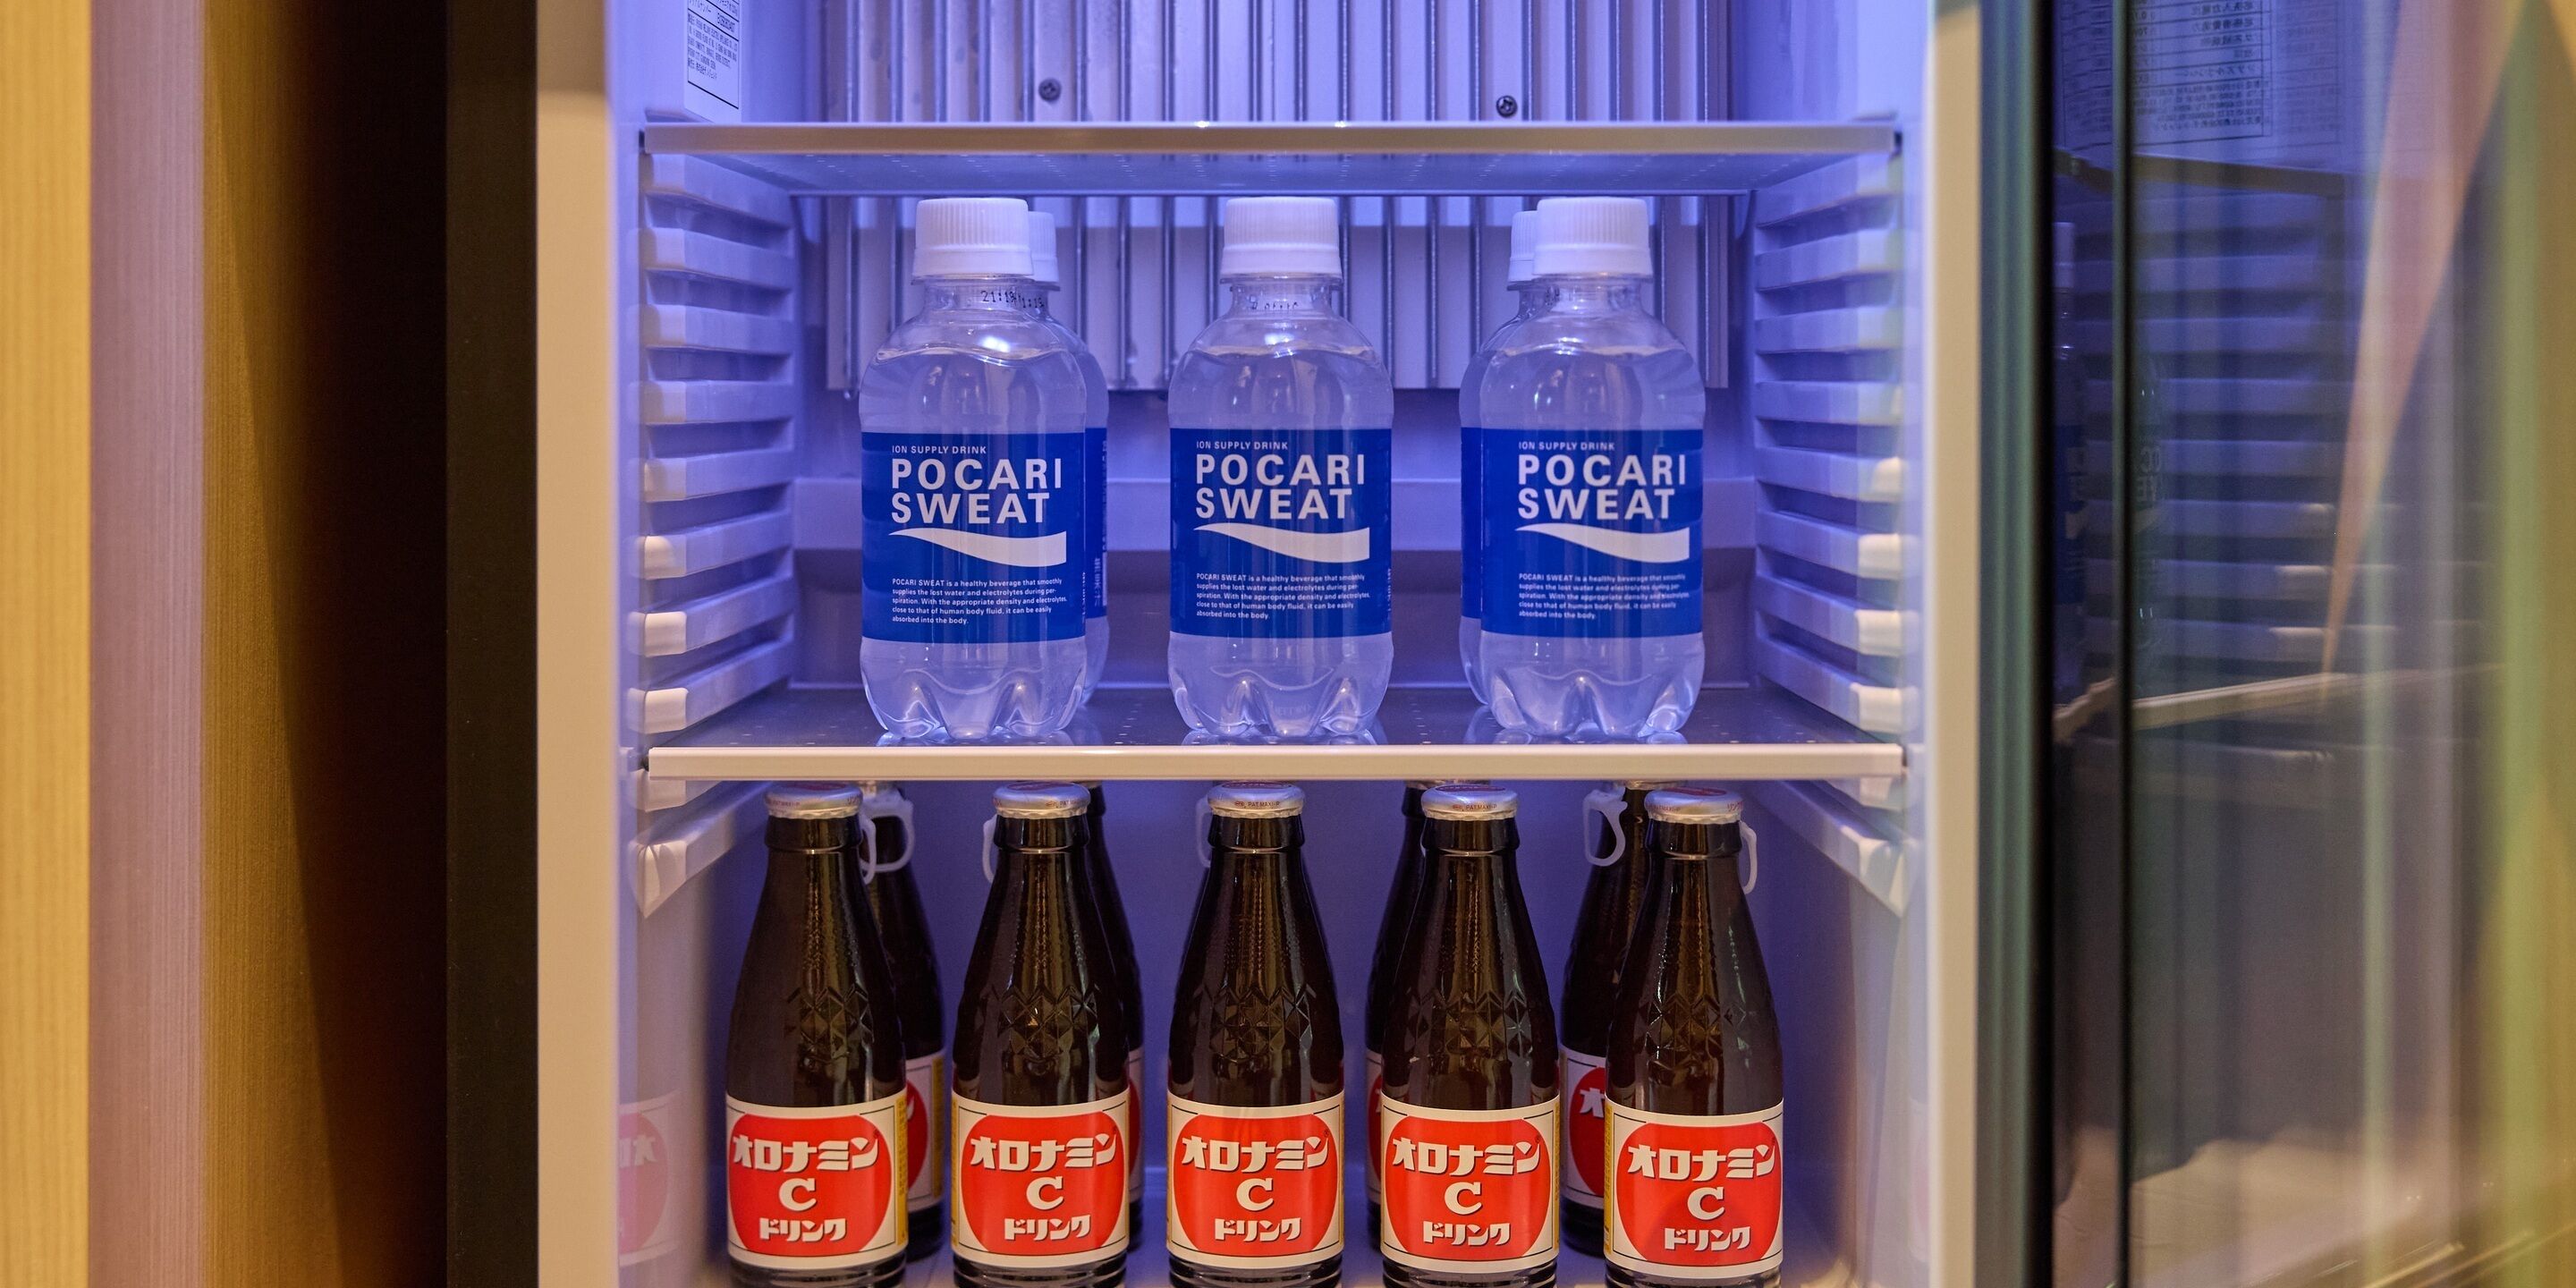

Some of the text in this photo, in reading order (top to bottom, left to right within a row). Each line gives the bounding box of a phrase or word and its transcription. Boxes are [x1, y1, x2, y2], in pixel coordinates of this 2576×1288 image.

[892, 445, 987, 454] ION SUPPLY DRINK
[1196, 441, 1288, 451] ION SUPPLY DRINK
[1519, 441, 1615, 452] ION SUPPLY DRINK
[892, 458, 1062, 490] POCARI
[1196, 453, 1365, 486] POCARI
[1518, 453, 1686, 487] POCARI
[891, 492, 1050, 524] SWEAT
[1196, 487, 1352, 520] SWEAT
[1518, 487, 1675, 521] SWEAT
[961, 580, 987, 589] healthy
[1196, 572, 1220, 580] POCARI
[1262, 575, 1288, 583] healthy
[1284, 584, 1325, 592] electrolytes
[893, 589, 916, 597] supplies
[1024, 588, 1045, 596] during
[952, 598, 994, 606] appropriate
[996, 597, 1021, 606] density
[1254, 593, 1296, 601] appropriate
[1298, 593, 1323, 601] density
[1337, 601, 1354, 609] easily
[893, 615, 919, 623] absorbed
[916, 606, 929, 614] that
[966, 607, 984, 616] body
[1035, 606, 1052, 614] easily
[733, 1134, 879, 1174] オロナミン
[970, 1133, 1117, 1173] オロナミン
[1182, 1135, 1329, 1173] オロナミン
[1392, 1137, 1541, 1176] オロナミン
[1627, 1144, 1776, 1182] オロナミン
[778, 1178, 817, 1212] C
[1026, 1175, 1065, 1211] C
[1236, 1177, 1275, 1212] C
[1444, 1182, 1482, 1216] C
[1687, 1186, 1725, 1221] C
[759, 1217, 847, 1242] ドリンク
[1004, 1214, 1091, 1241] ドリンク
[1215, 1217, 1301, 1242] ドリンク
[1423, 1220, 1512, 1246] ドリンク
[1665, 1226, 1751, 1251] ドリンク
